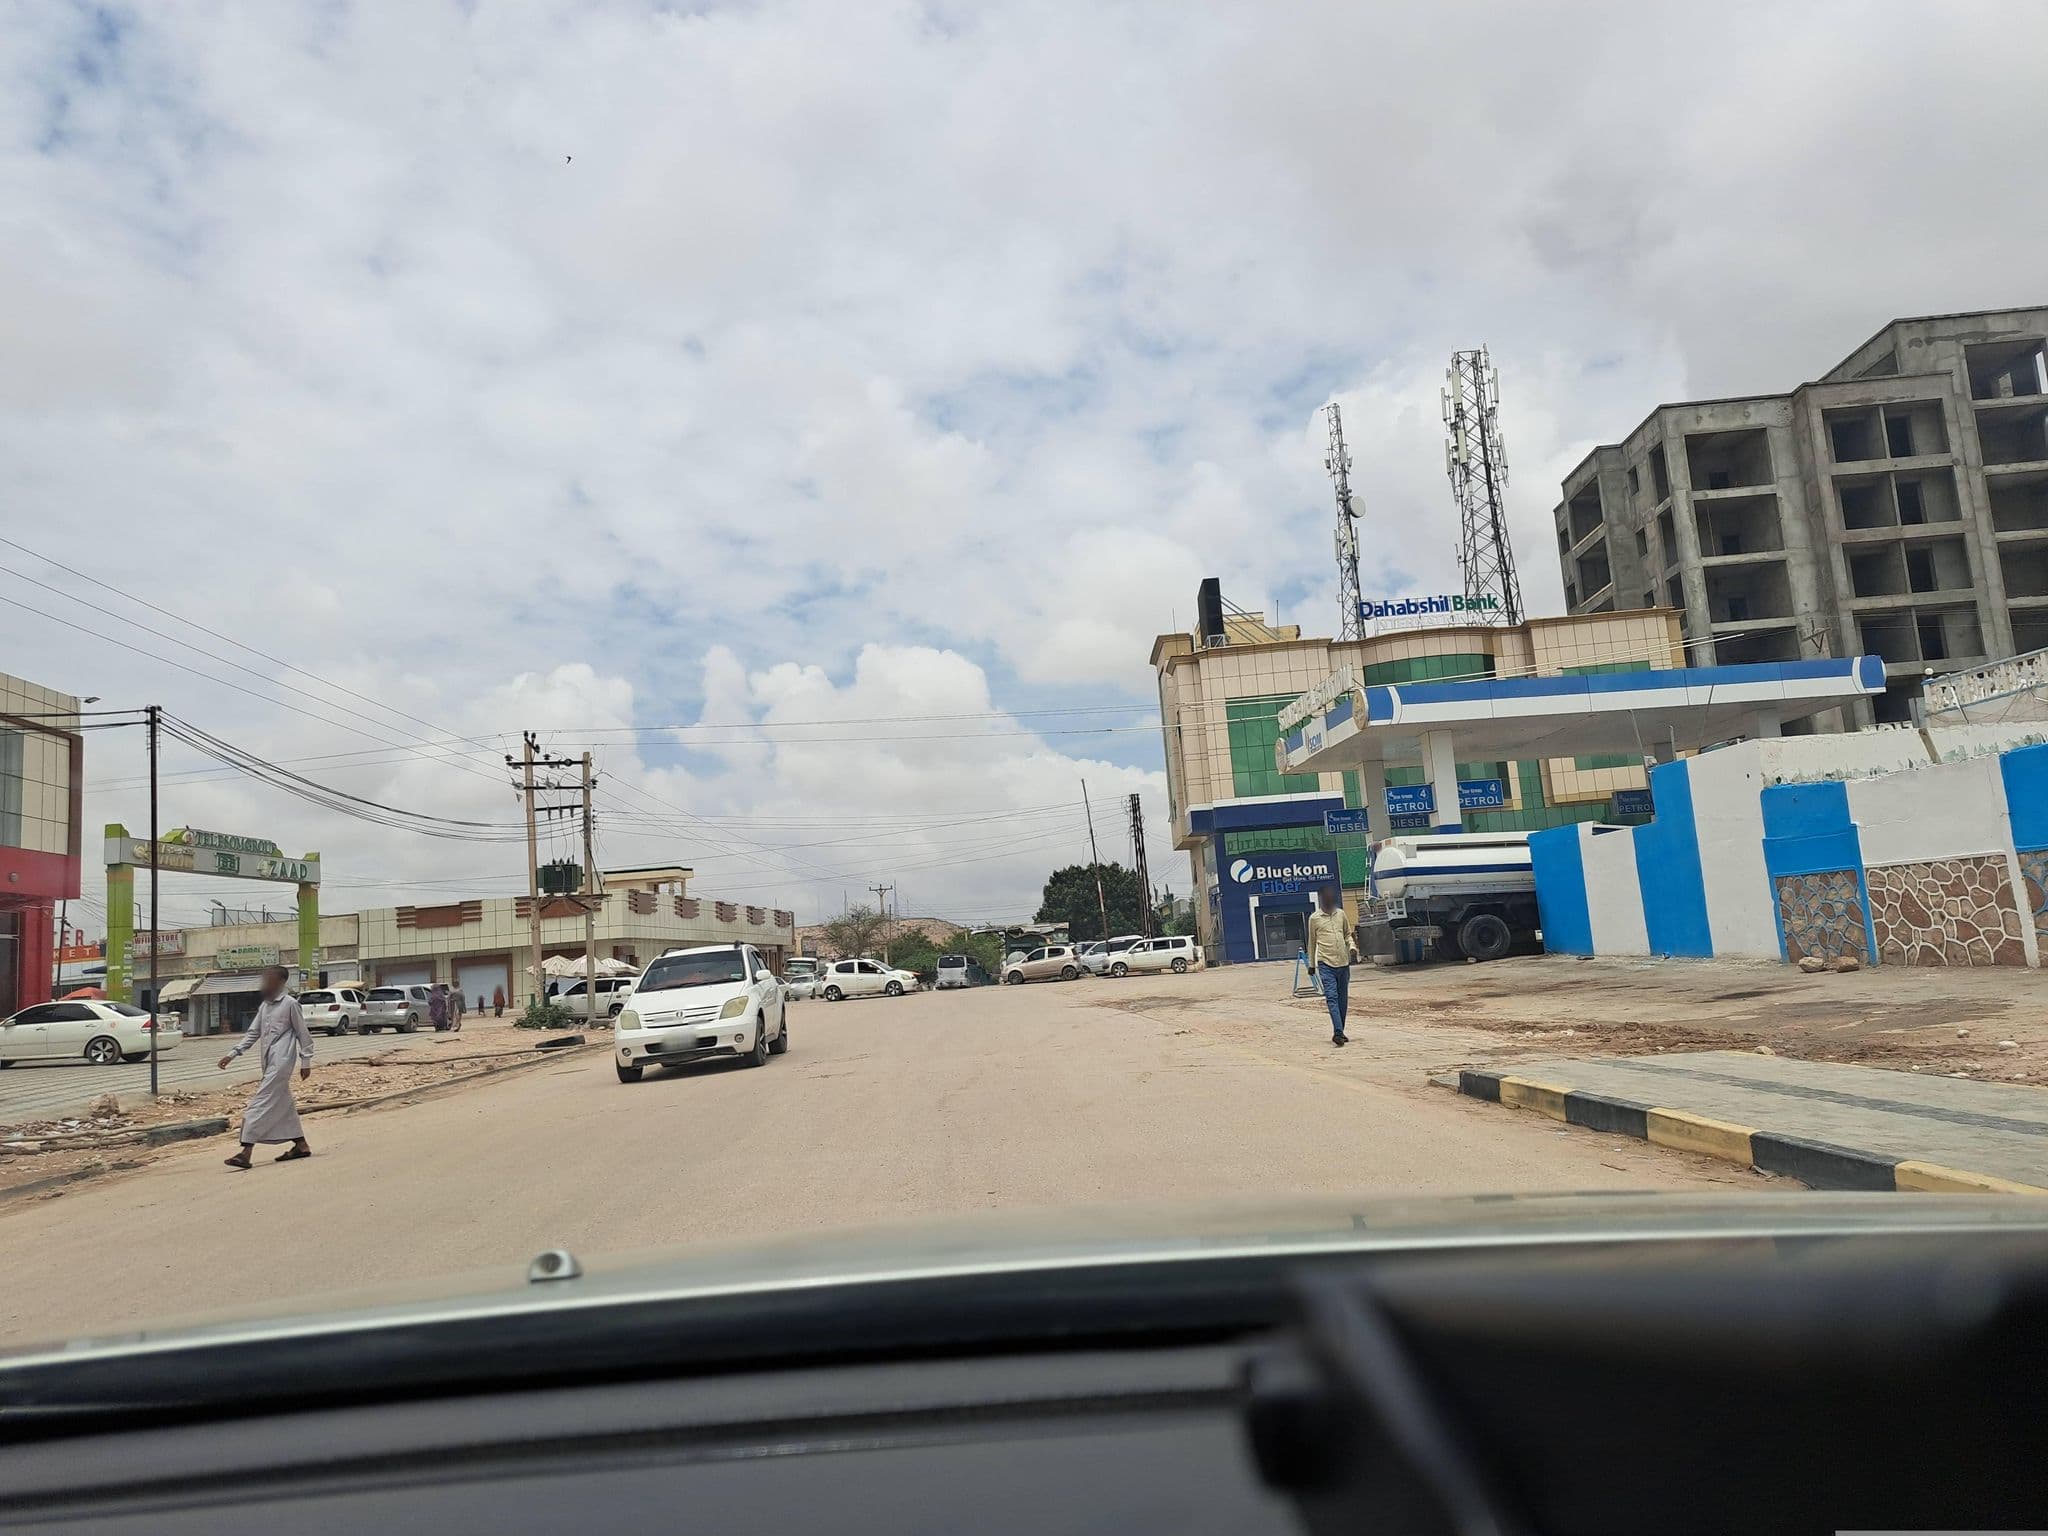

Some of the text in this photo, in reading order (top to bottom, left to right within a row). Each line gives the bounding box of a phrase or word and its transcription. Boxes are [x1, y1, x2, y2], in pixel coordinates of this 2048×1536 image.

[1360, 593, 1498, 620] Dahabshil Bank
[1420, 787, 1427, 798] 4
[1490, 783, 1496, 792] 4
[1460, 796, 1502, 806] PETROL
[1389, 801, 1431, 813] PETROL
[1358, 811, 1364, 820] 2
[1329, 822, 1369, 833] DIESEL
[1391, 818, 1429, 828] DIESEL
[269, 860, 308, 880] ZAAD
[1256, 863, 1328, 879] Bluekom
[1260, 881, 1302, 893] Fiber
[54, 930, 84, 947] ER
